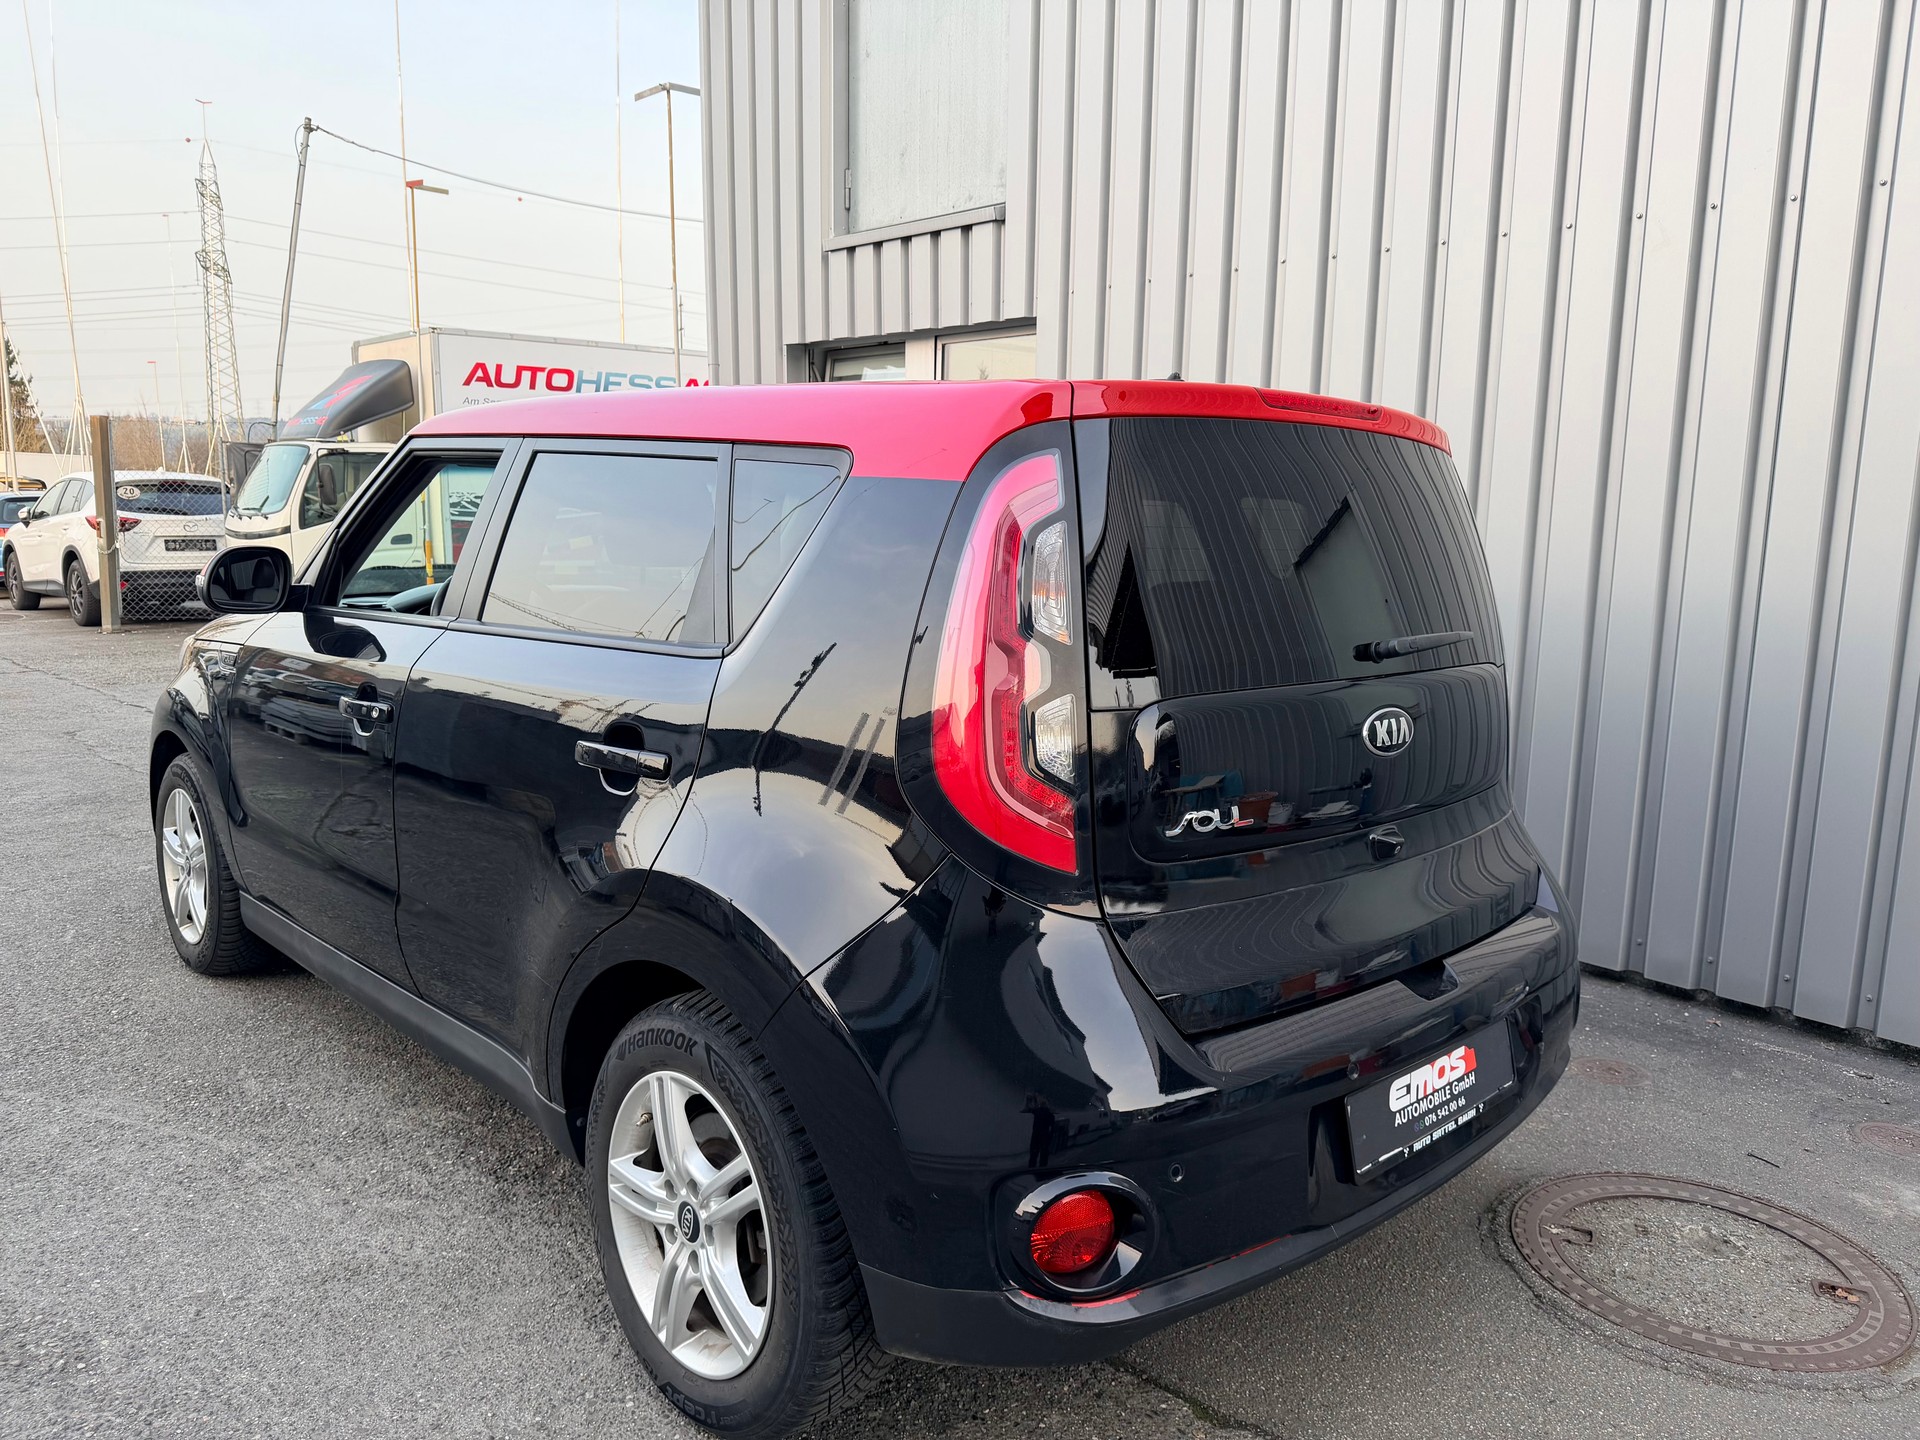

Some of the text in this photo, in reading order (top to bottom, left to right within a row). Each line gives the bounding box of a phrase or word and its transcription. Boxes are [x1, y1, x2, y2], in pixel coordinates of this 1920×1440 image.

[1373, 717, 1411, 747] KIA
[1165, 805, 1254, 837] SOUL
[1394, 1071, 1476, 1128] AUTOMOBILE GmbH
[1424, 1095, 1466, 1127] 076 542 00 66
[1413, 1135, 1431, 1152] AUTO
